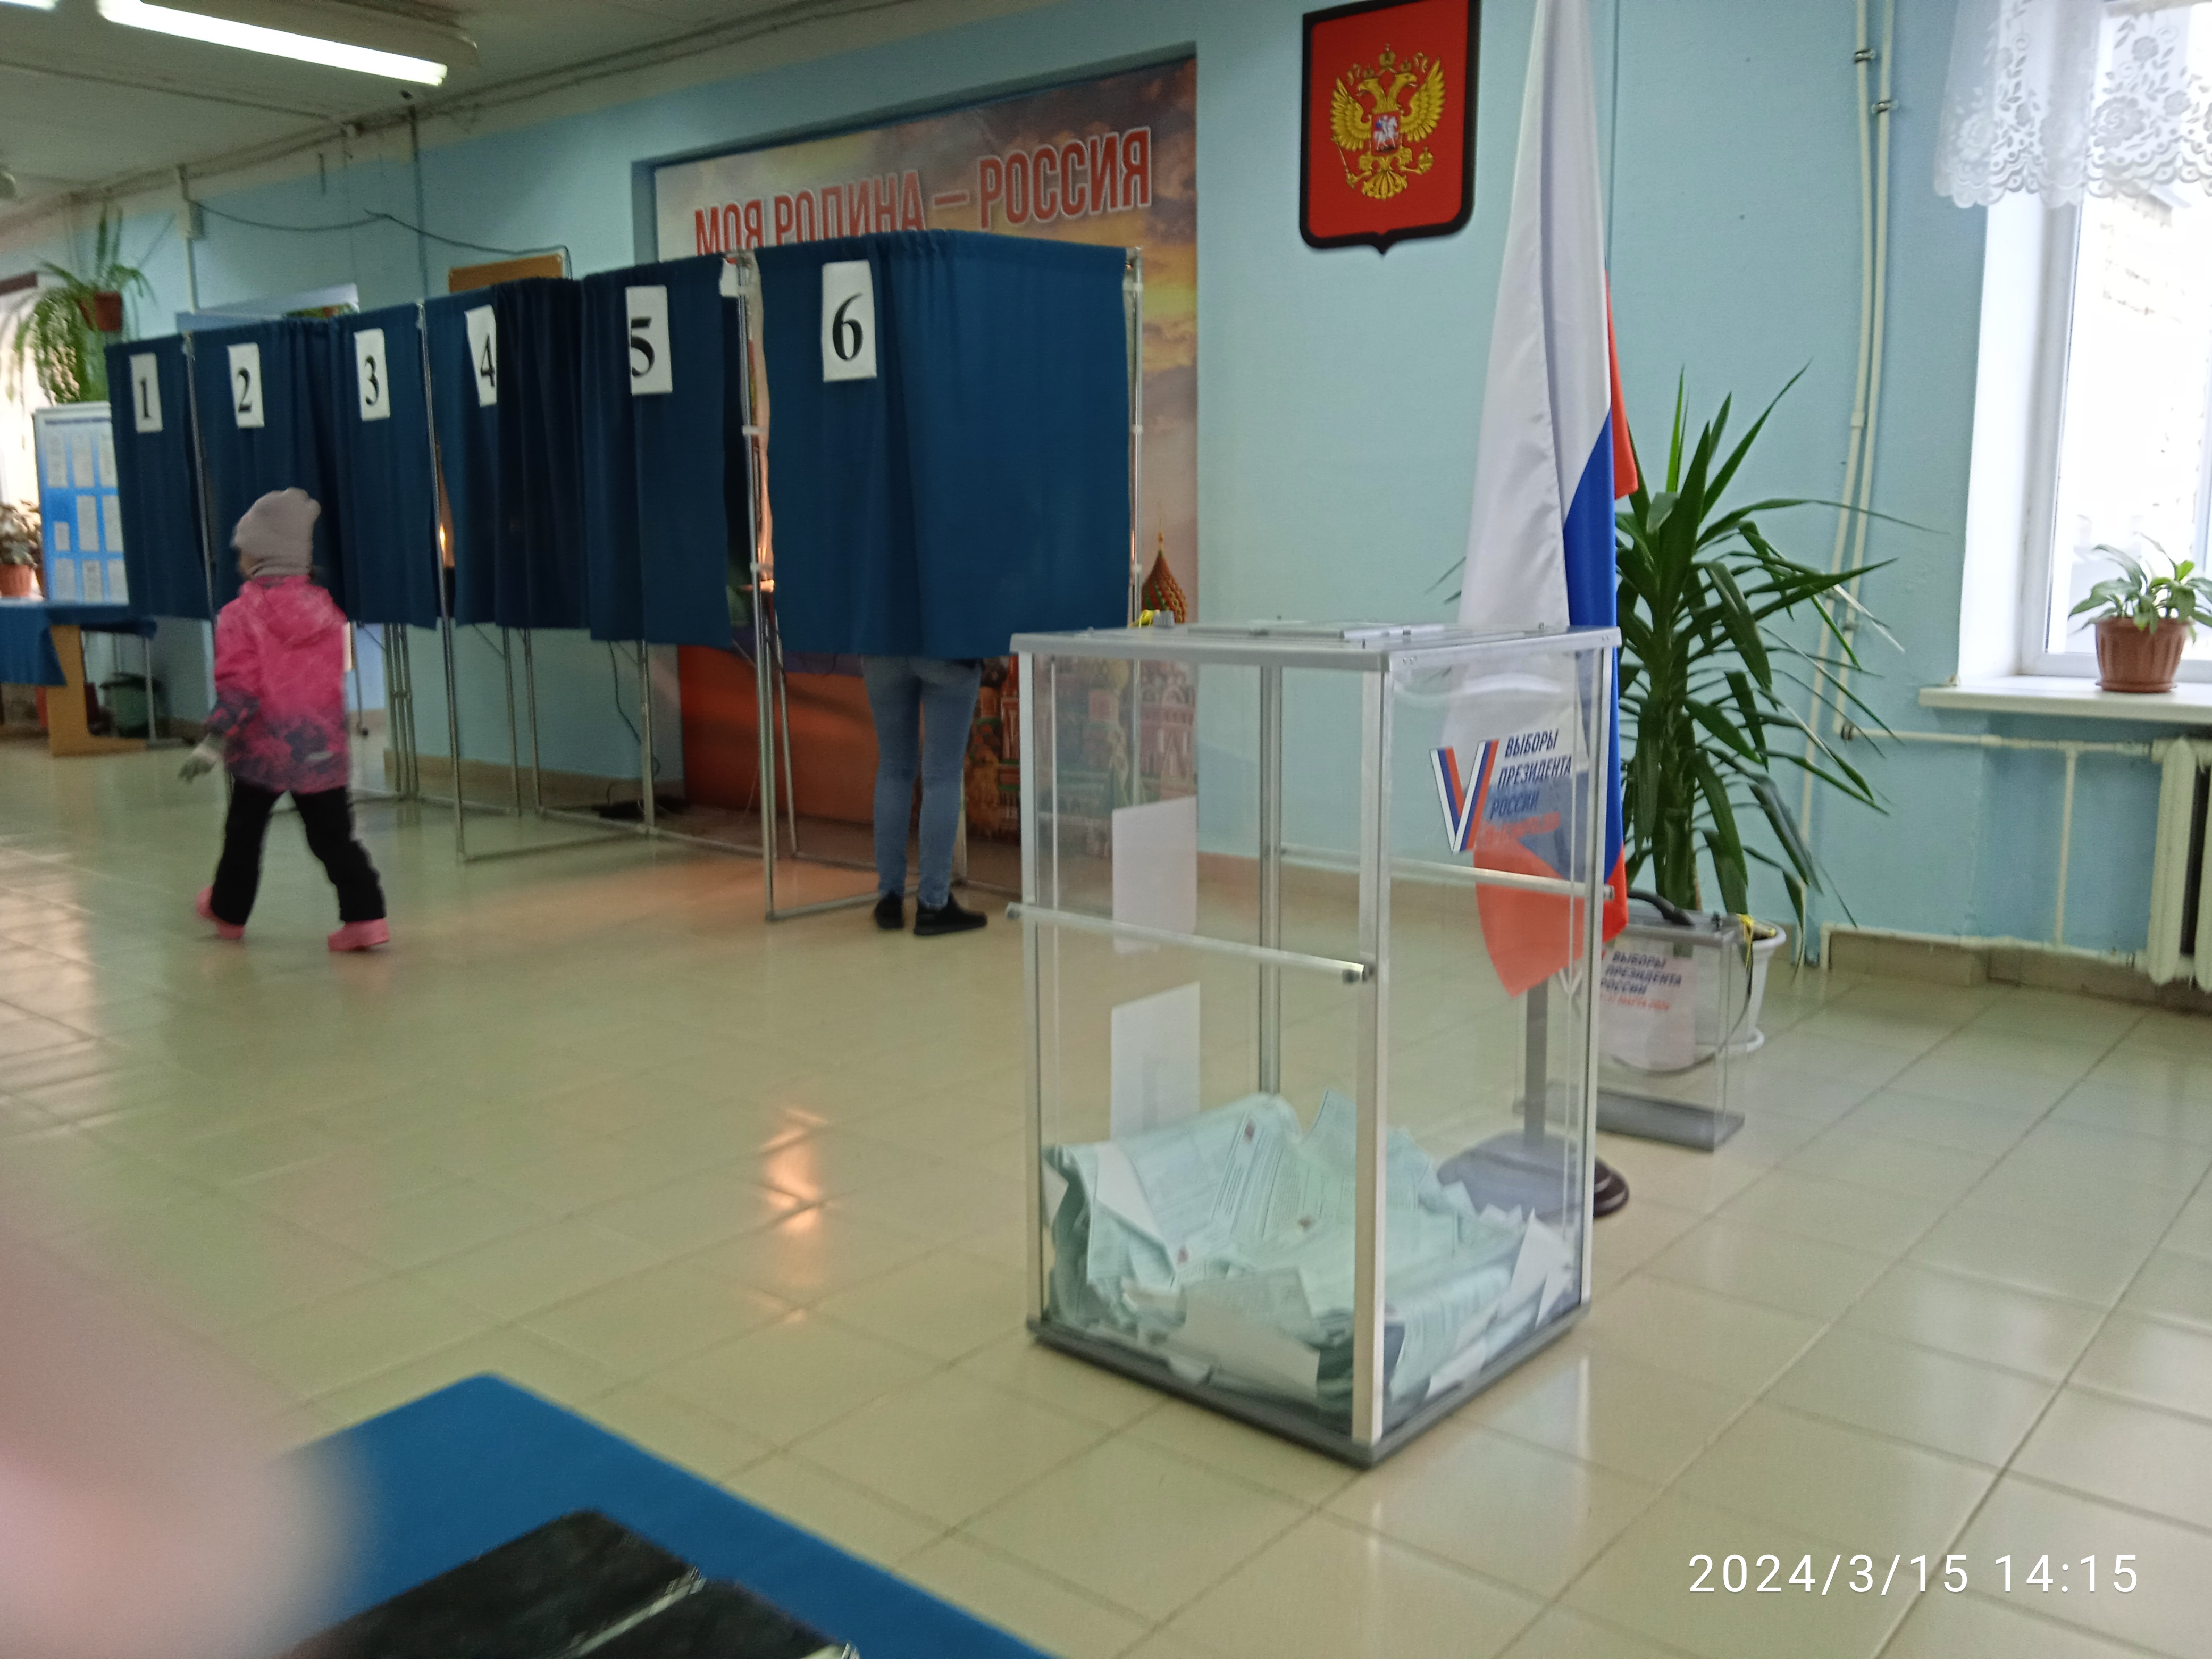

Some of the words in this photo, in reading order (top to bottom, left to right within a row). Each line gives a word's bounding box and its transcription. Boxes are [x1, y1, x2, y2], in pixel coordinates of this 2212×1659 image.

[694, 199, 764, 257] МОЯ
[978, 128, 1151, 229] РОССИЯ
[630, 317, 655, 377] 5
[831, 293, 864, 361] 6
[365, 356, 380, 406] 3
[480, 333, 495, 388] 4
[139, 378, 151, 419] 1
[237, 367, 253, 412] 2
[1504, 728, 1559, 759] ВЫБОРЫ
[1497, 753, 1572, 791] ПРЕЗИДЕНТА
